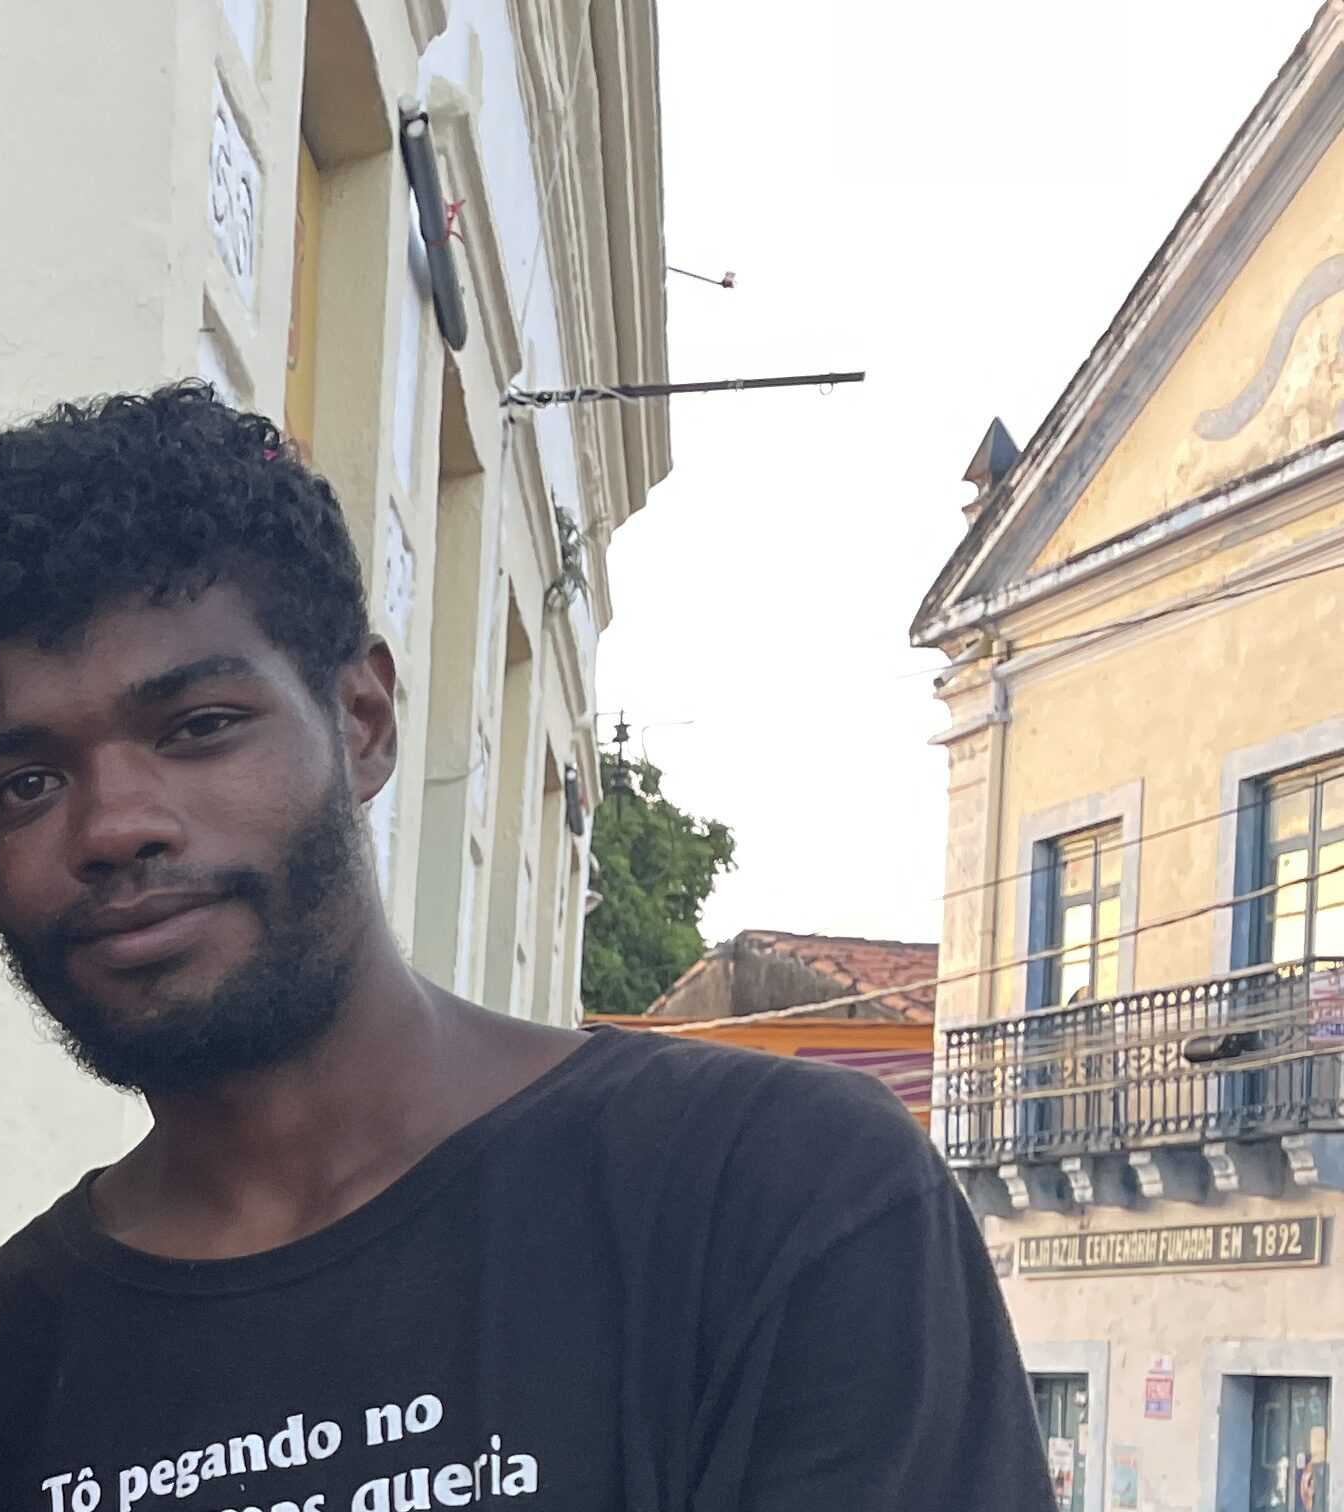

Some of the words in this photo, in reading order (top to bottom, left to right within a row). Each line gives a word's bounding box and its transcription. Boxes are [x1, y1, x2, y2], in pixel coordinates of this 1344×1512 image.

[1052, 1236, 1082, 1266] AZUL
[1253, 1222, 1302, 1256] 1892
[365, 1394, 443, 1446] no
